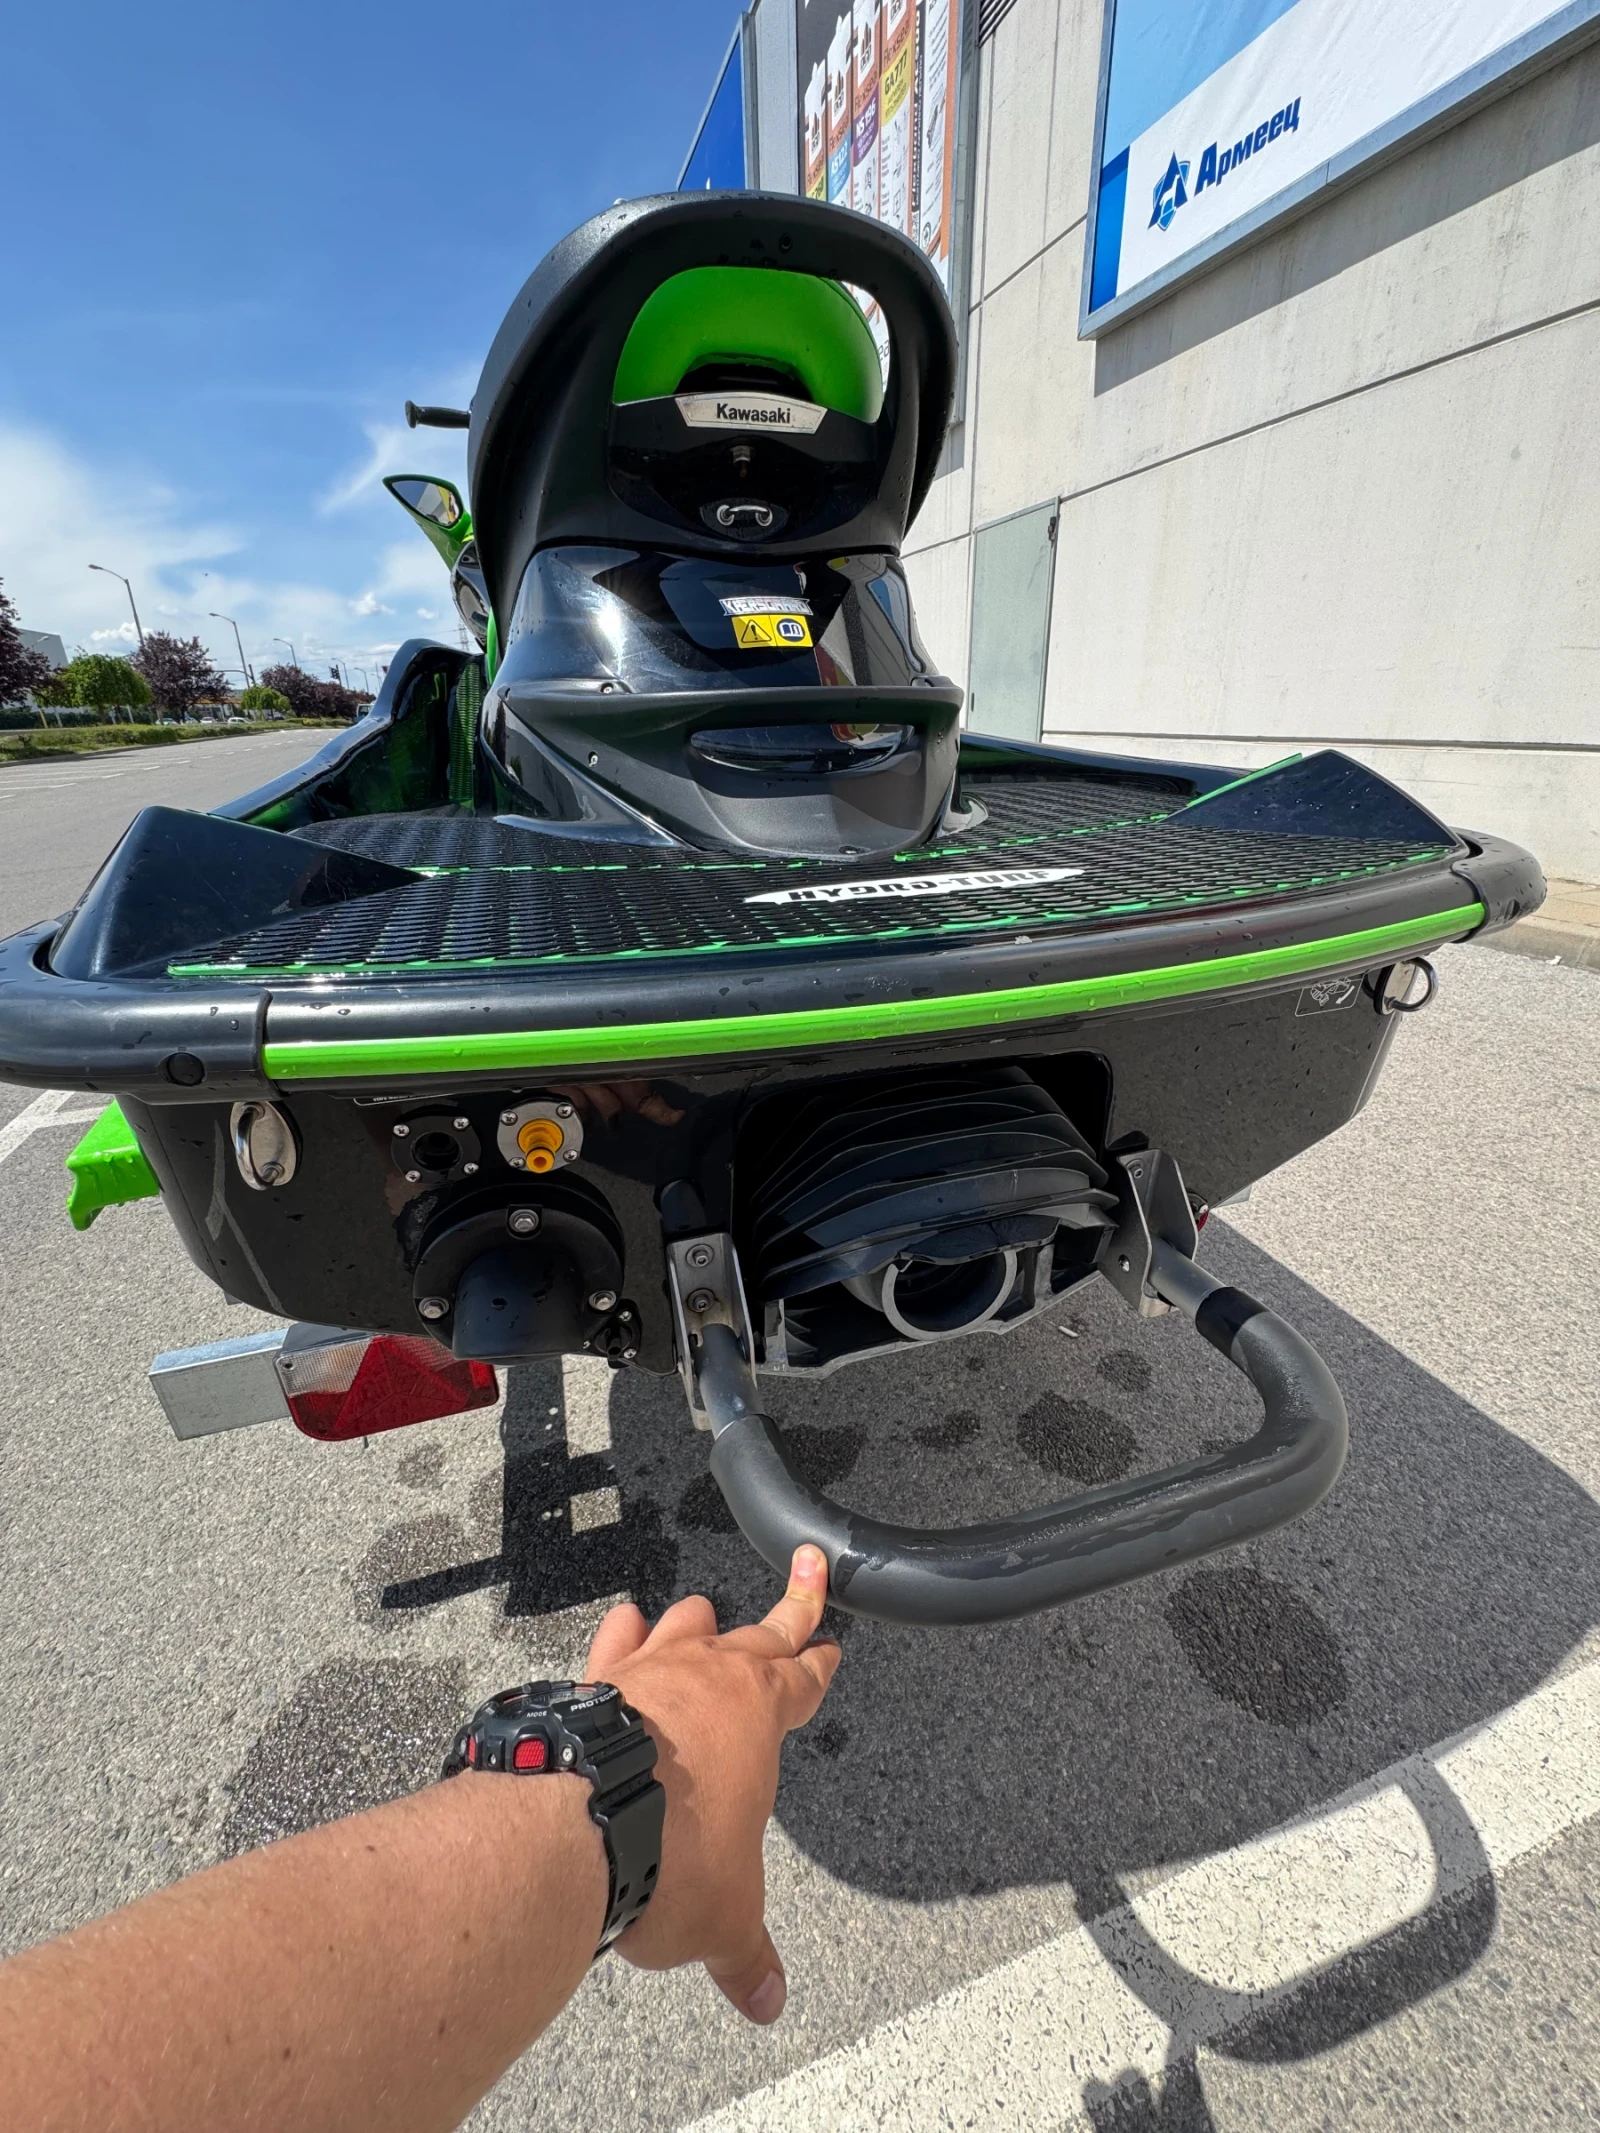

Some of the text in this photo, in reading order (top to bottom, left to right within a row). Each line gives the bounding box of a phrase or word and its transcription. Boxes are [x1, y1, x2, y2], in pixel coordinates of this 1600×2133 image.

[894, 48, 908, 83] 777
[1194, 96, 1301, 197] Армеец
[716, 402, 791, 424] Kawasaki
[788, 869, 1051, 901] HYDRO-TURF
[526, 1710, 547, 1718] MODE
